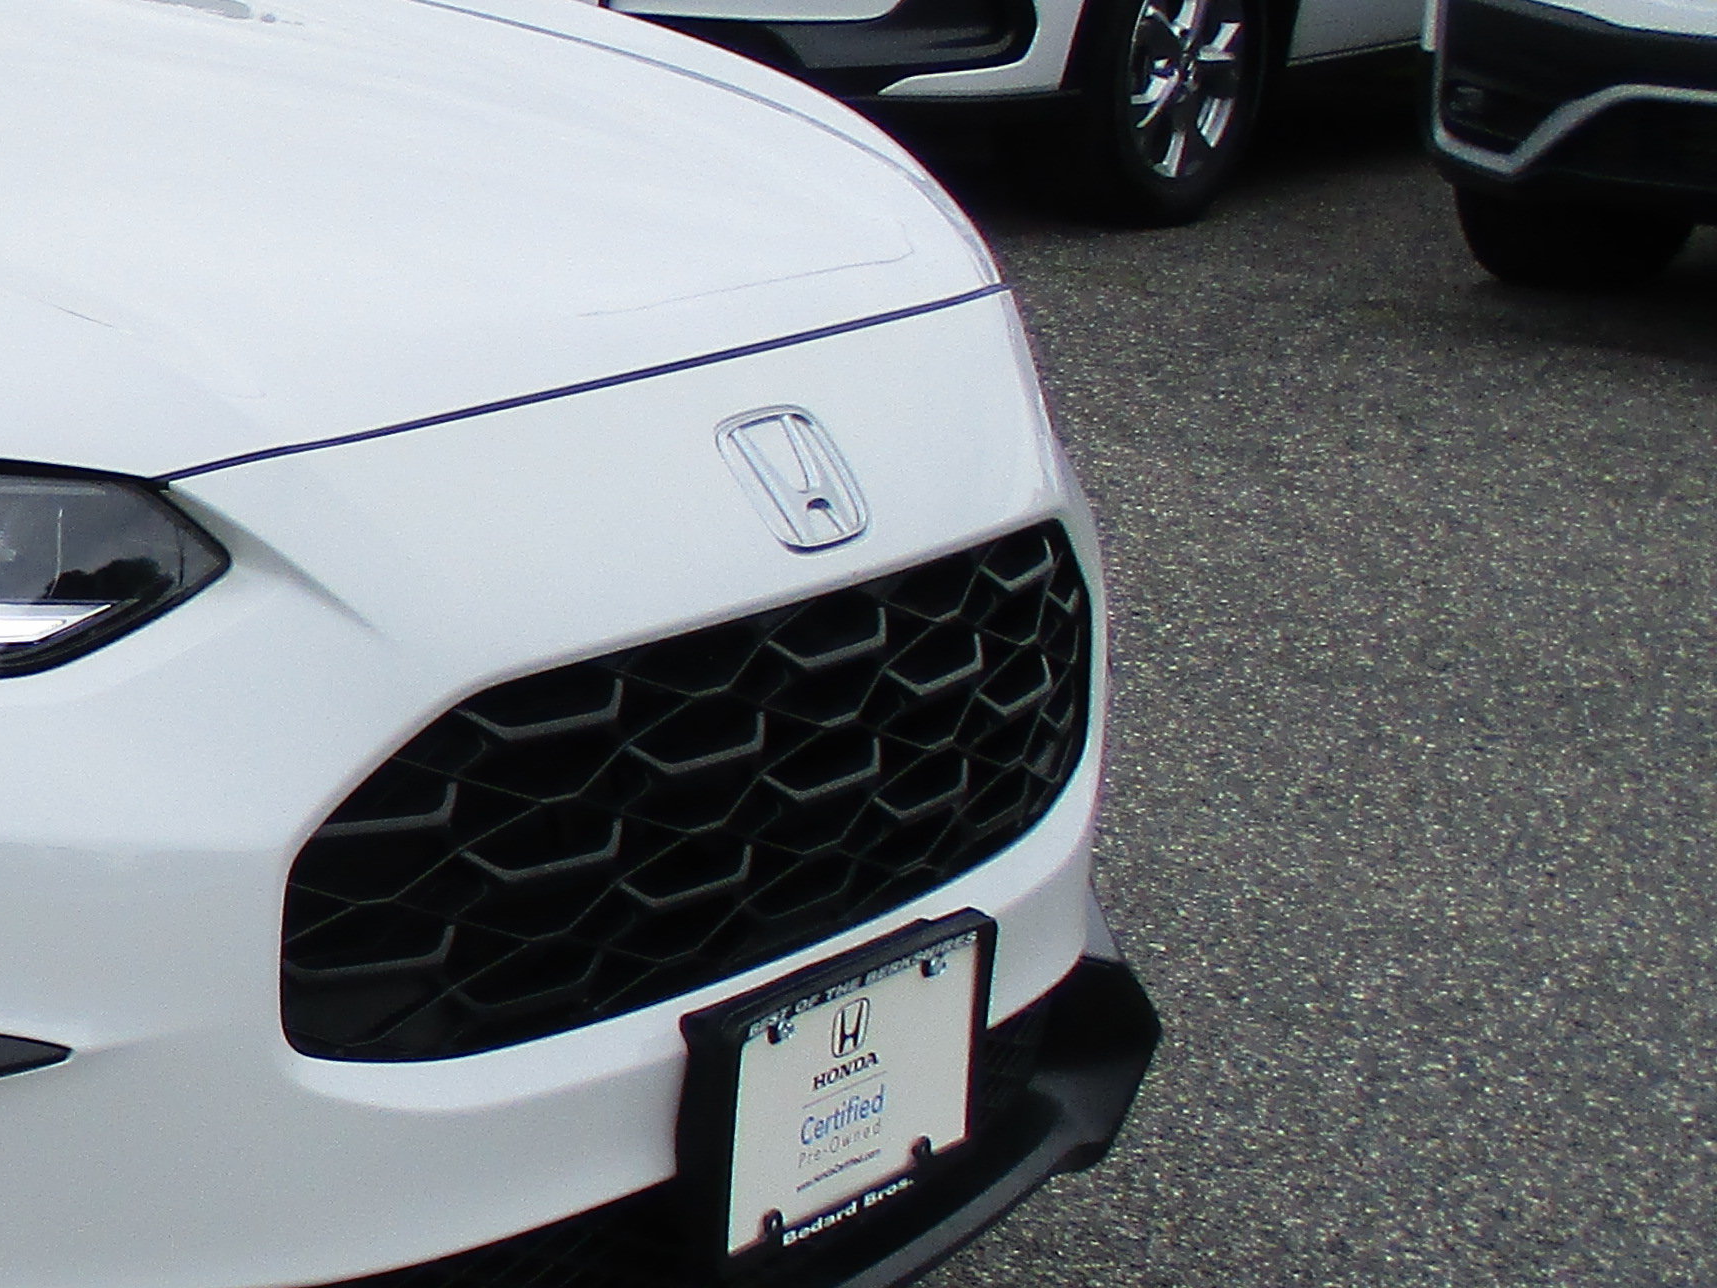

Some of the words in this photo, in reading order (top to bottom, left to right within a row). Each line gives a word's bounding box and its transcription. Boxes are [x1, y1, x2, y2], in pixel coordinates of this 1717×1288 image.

[795, 994, 820, 1015] OF
[825, 976, 863, 1002] THE
[812, 1053, 879, 1091] HONDA
[800, 1084, 885, 1145] Certified
[797, 1117, 882, 1169] Pre-Owned
[782, 1200, 858, 1247] Bedard
[863, 1176, 915, 1208] Bros.
